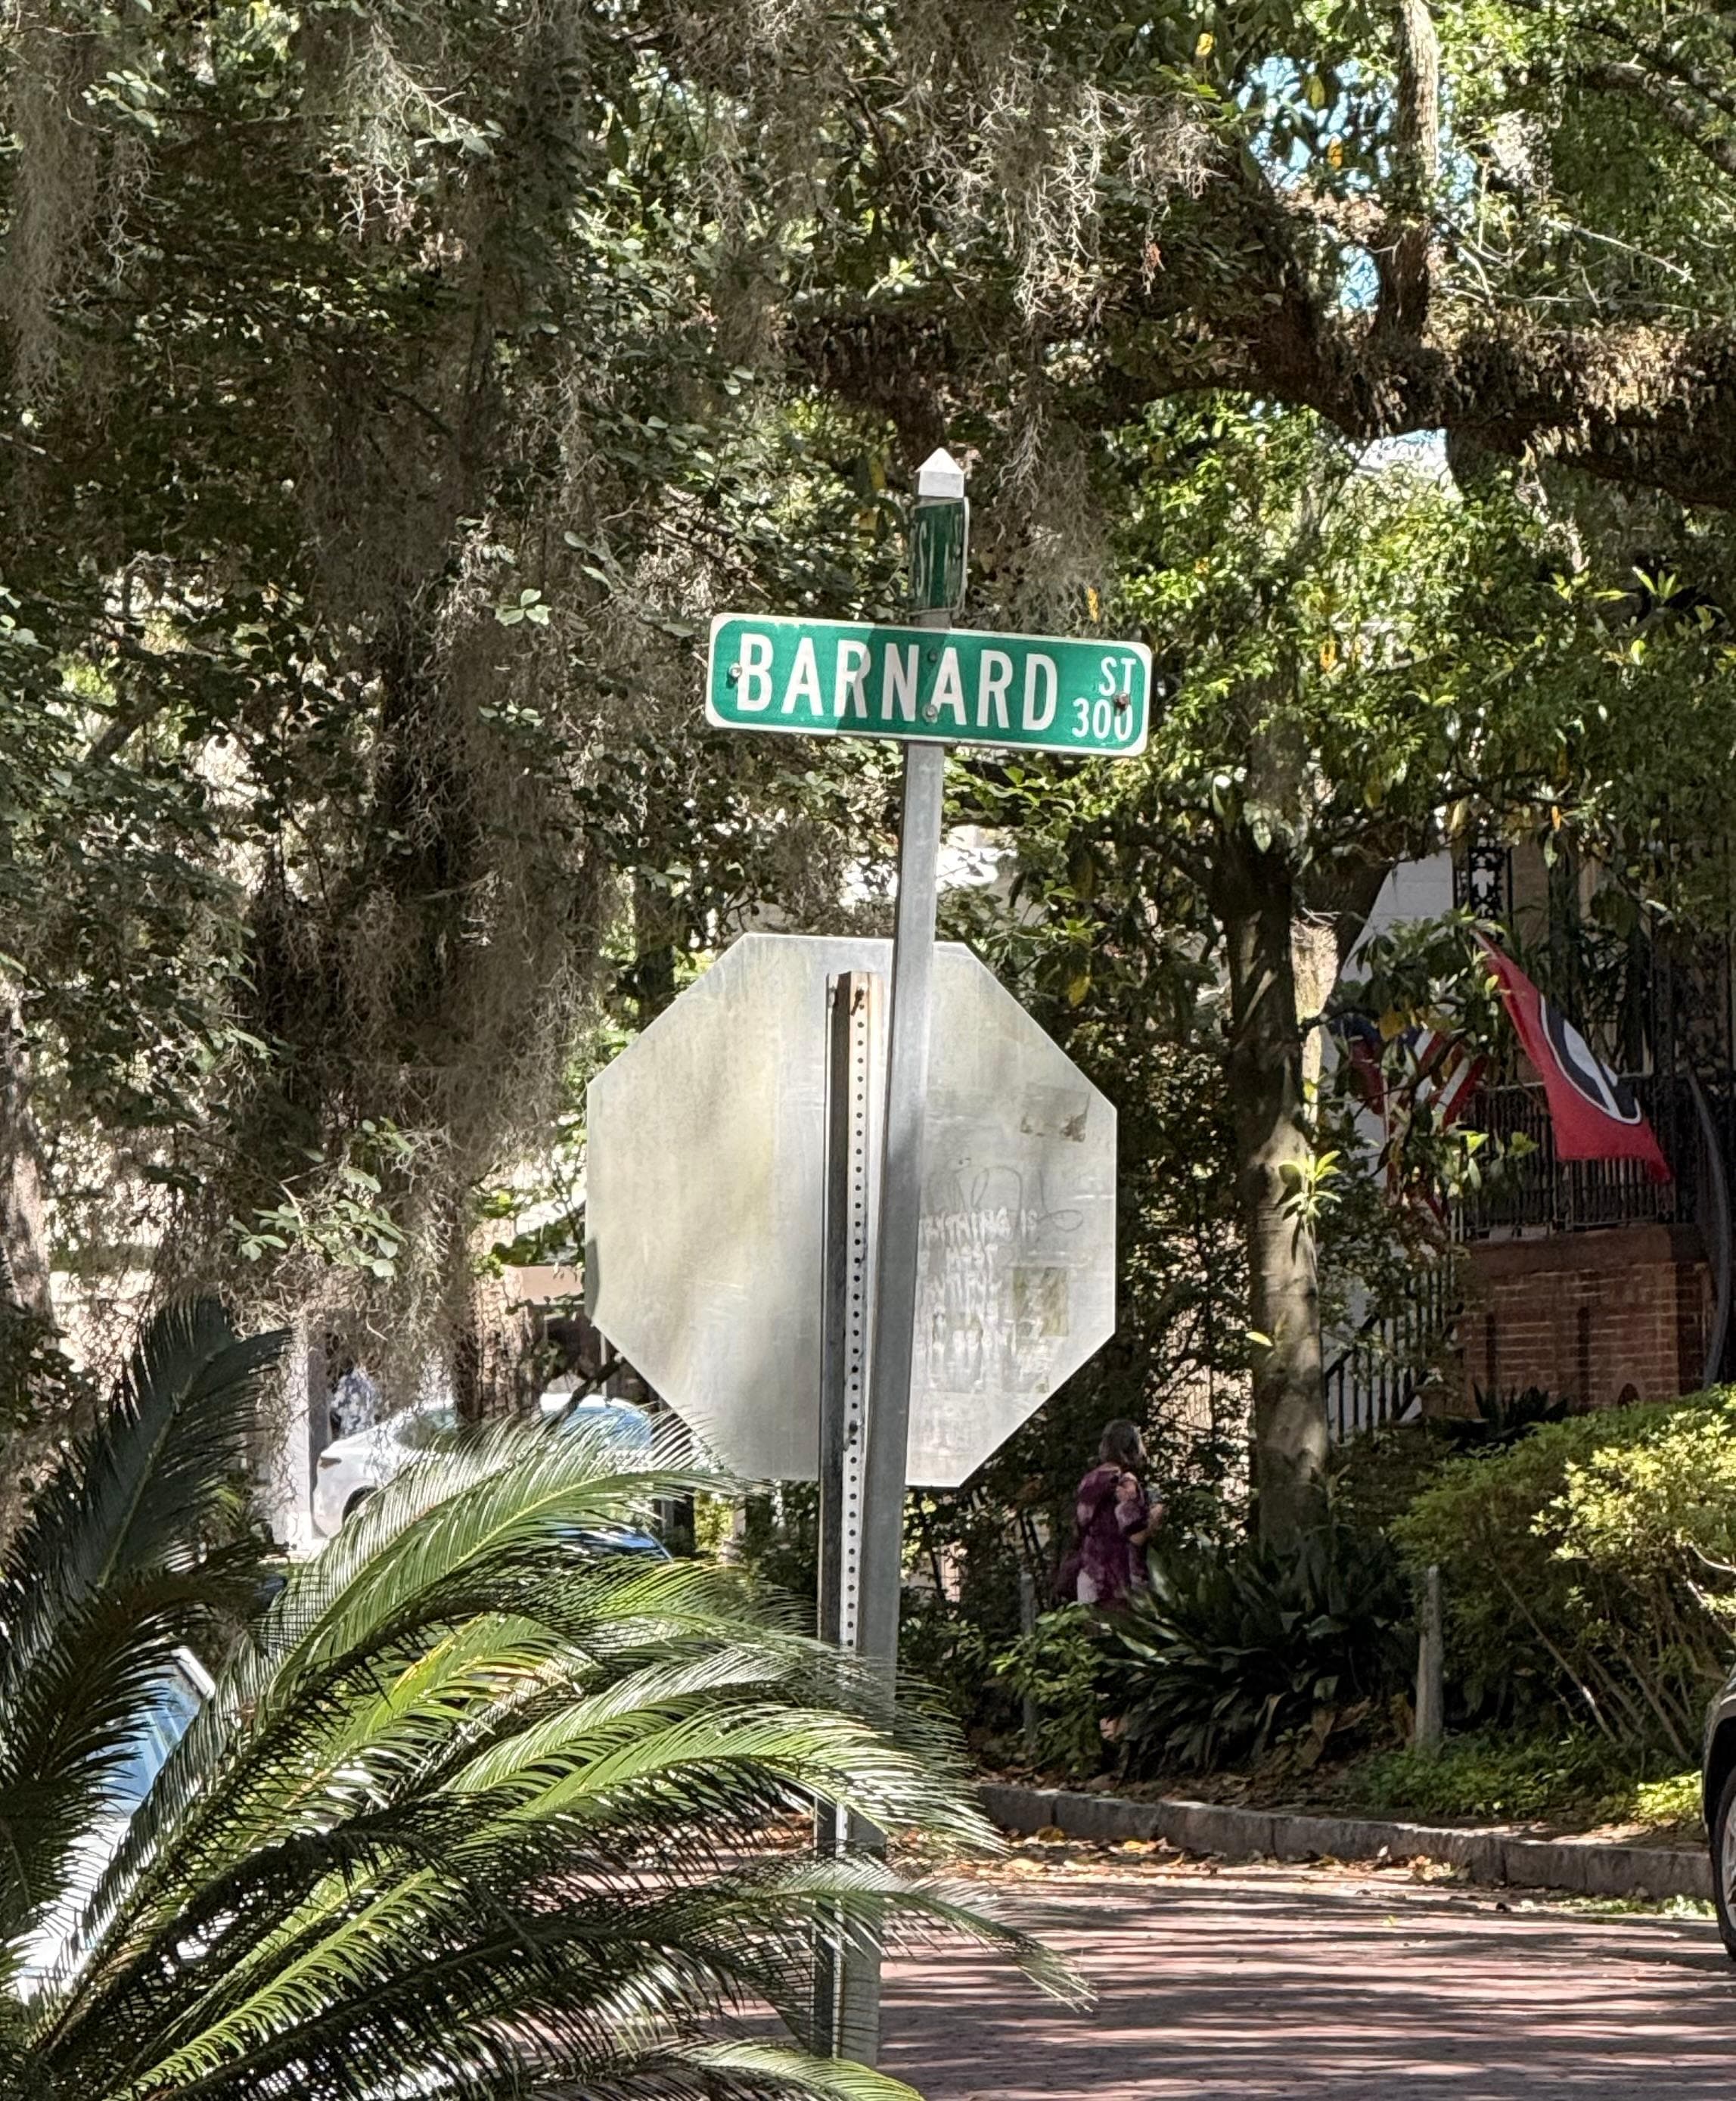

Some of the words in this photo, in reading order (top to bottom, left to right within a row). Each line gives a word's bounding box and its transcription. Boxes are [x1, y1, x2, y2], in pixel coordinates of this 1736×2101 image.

[737, 632, 1057, 731] BARNARD
[1098, 656, 1136, 696] ST
[1072, 697, 1133, 741] 300
